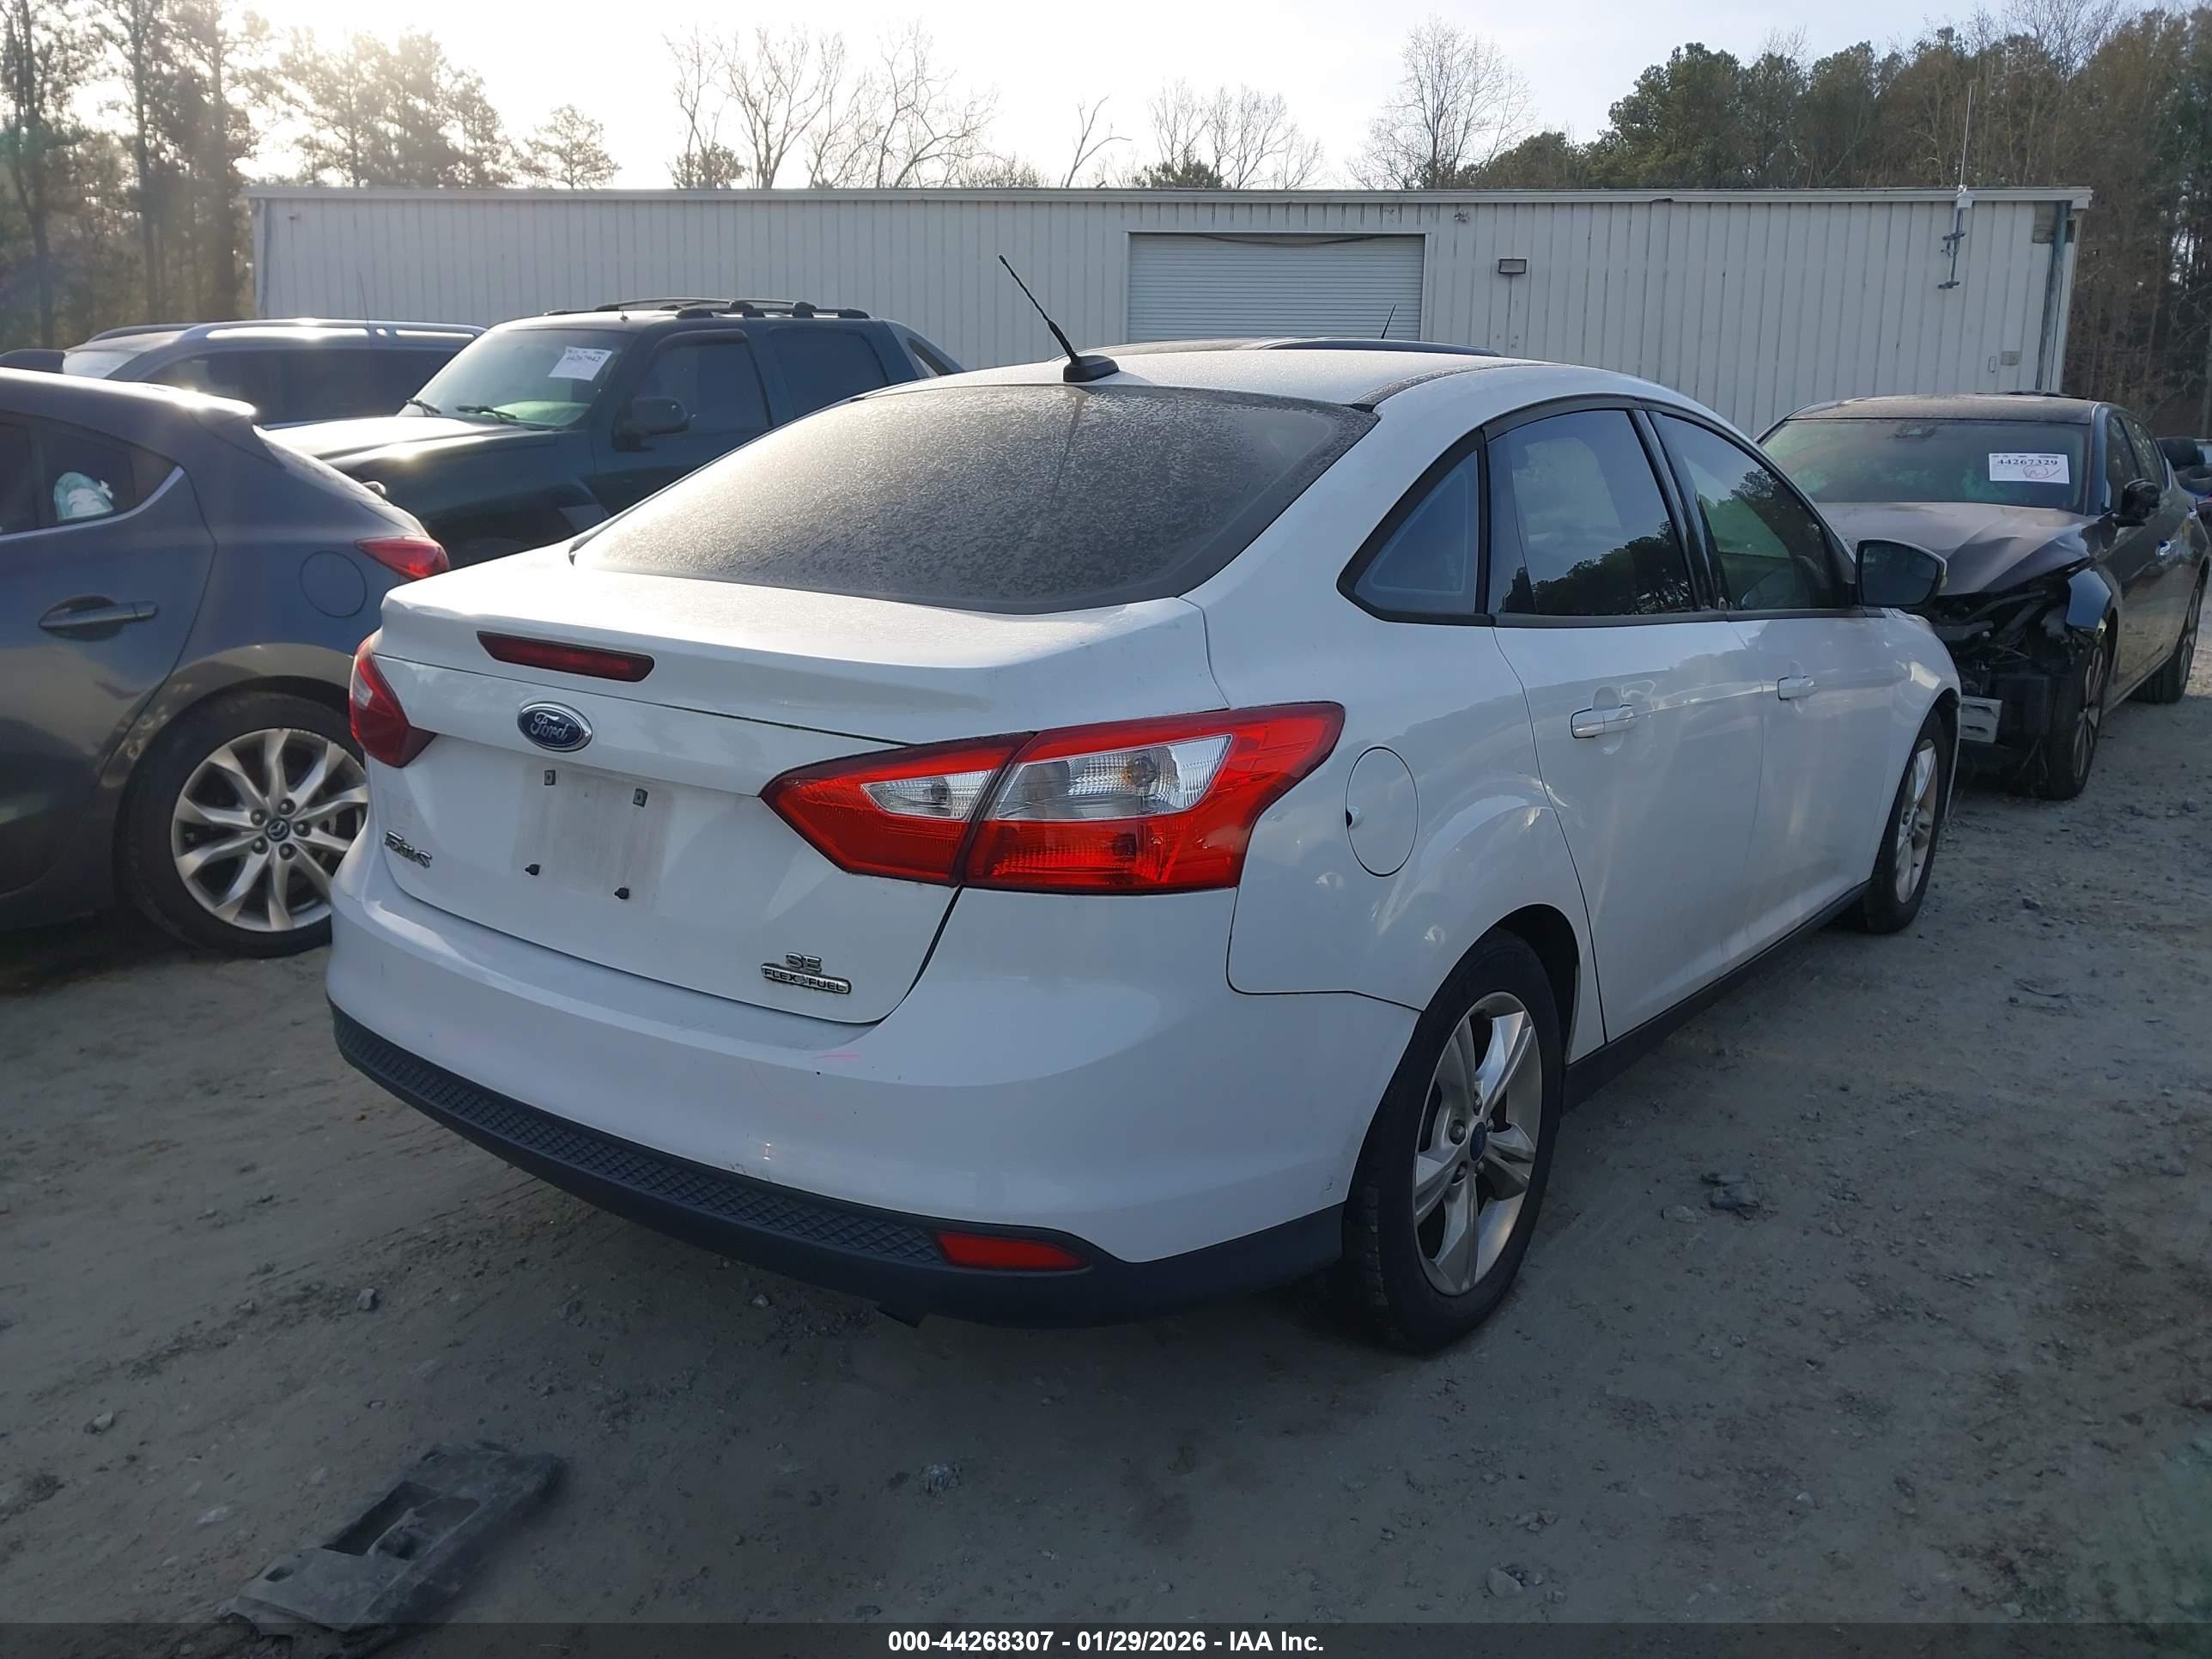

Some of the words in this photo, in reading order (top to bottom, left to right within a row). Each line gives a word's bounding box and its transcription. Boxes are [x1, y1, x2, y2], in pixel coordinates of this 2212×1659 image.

[530, 712, 572, 740] Ford
[786, 952, 822, 972] SE
[763, 968, 798, 983] FLEX
[808, 977, 848, 992] FUEL
